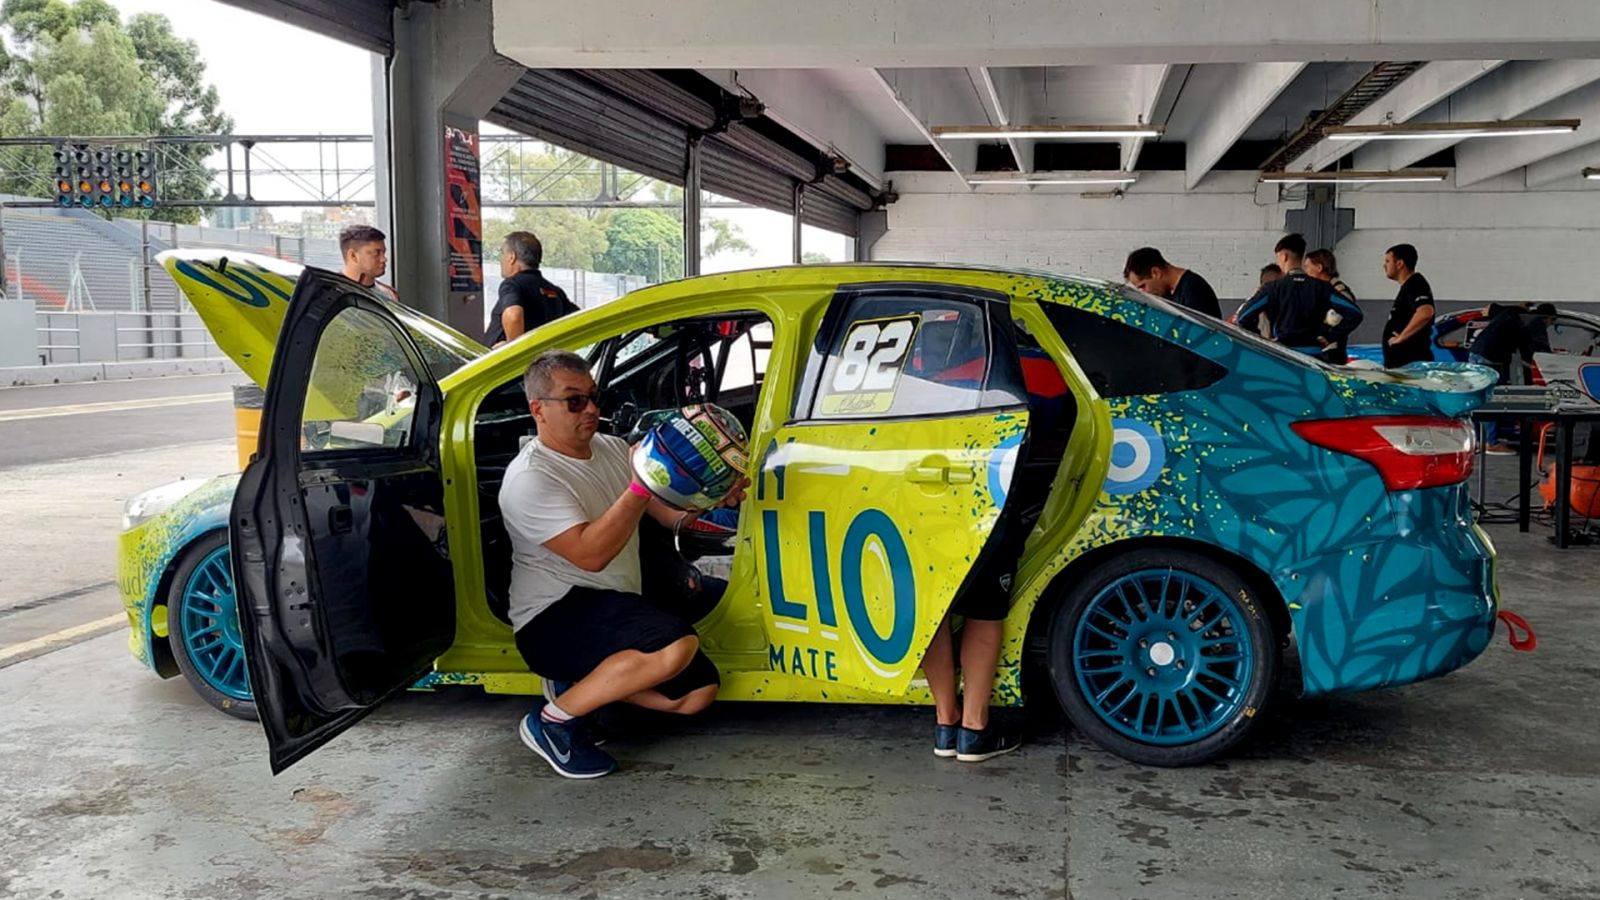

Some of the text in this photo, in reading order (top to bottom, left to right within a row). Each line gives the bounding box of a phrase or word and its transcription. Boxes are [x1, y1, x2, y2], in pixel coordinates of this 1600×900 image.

[833, 320, 914, 392] 82
[762, 508, 916, 665] LIO
[769, 643, 839, 682] MATE
